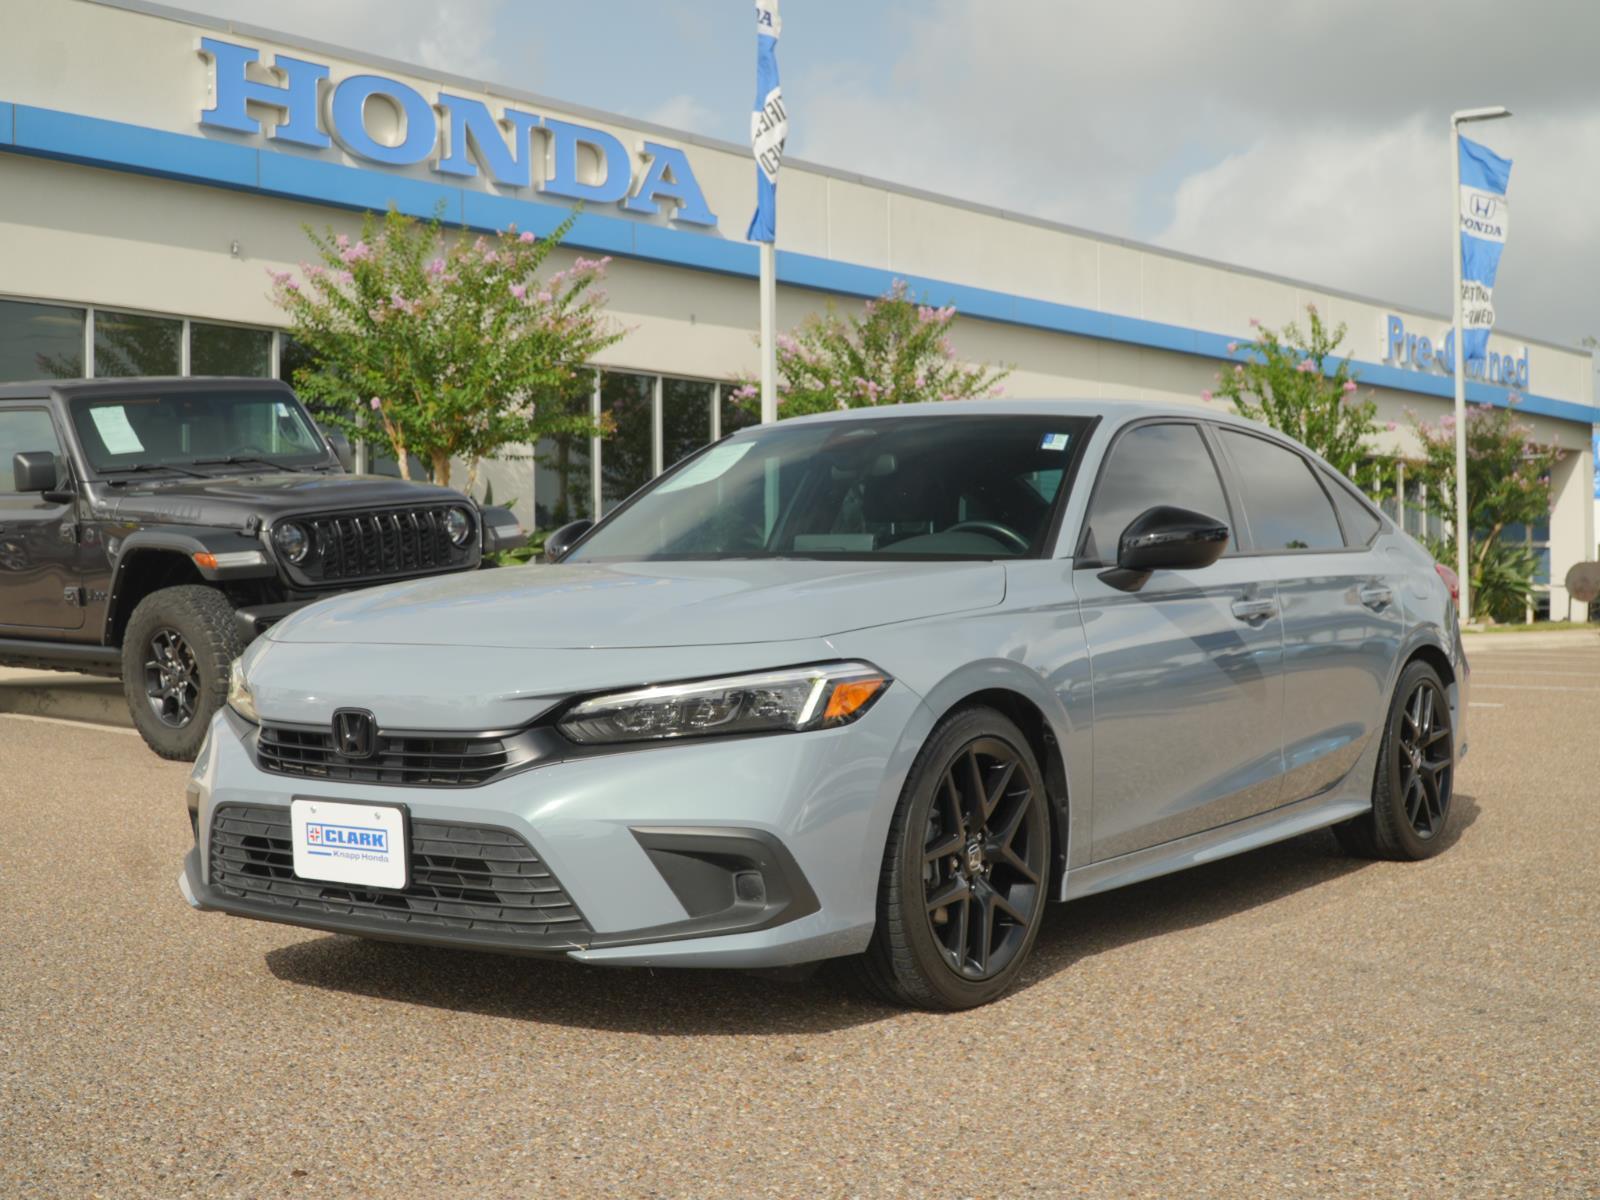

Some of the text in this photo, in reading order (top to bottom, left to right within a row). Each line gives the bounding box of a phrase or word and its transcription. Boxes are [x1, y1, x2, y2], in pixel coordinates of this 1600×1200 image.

[200, 37, 717, 226] HONDA
[325, 829, 384, 847] CLARK
[333, 850, 389, 863] Knapp Honda
